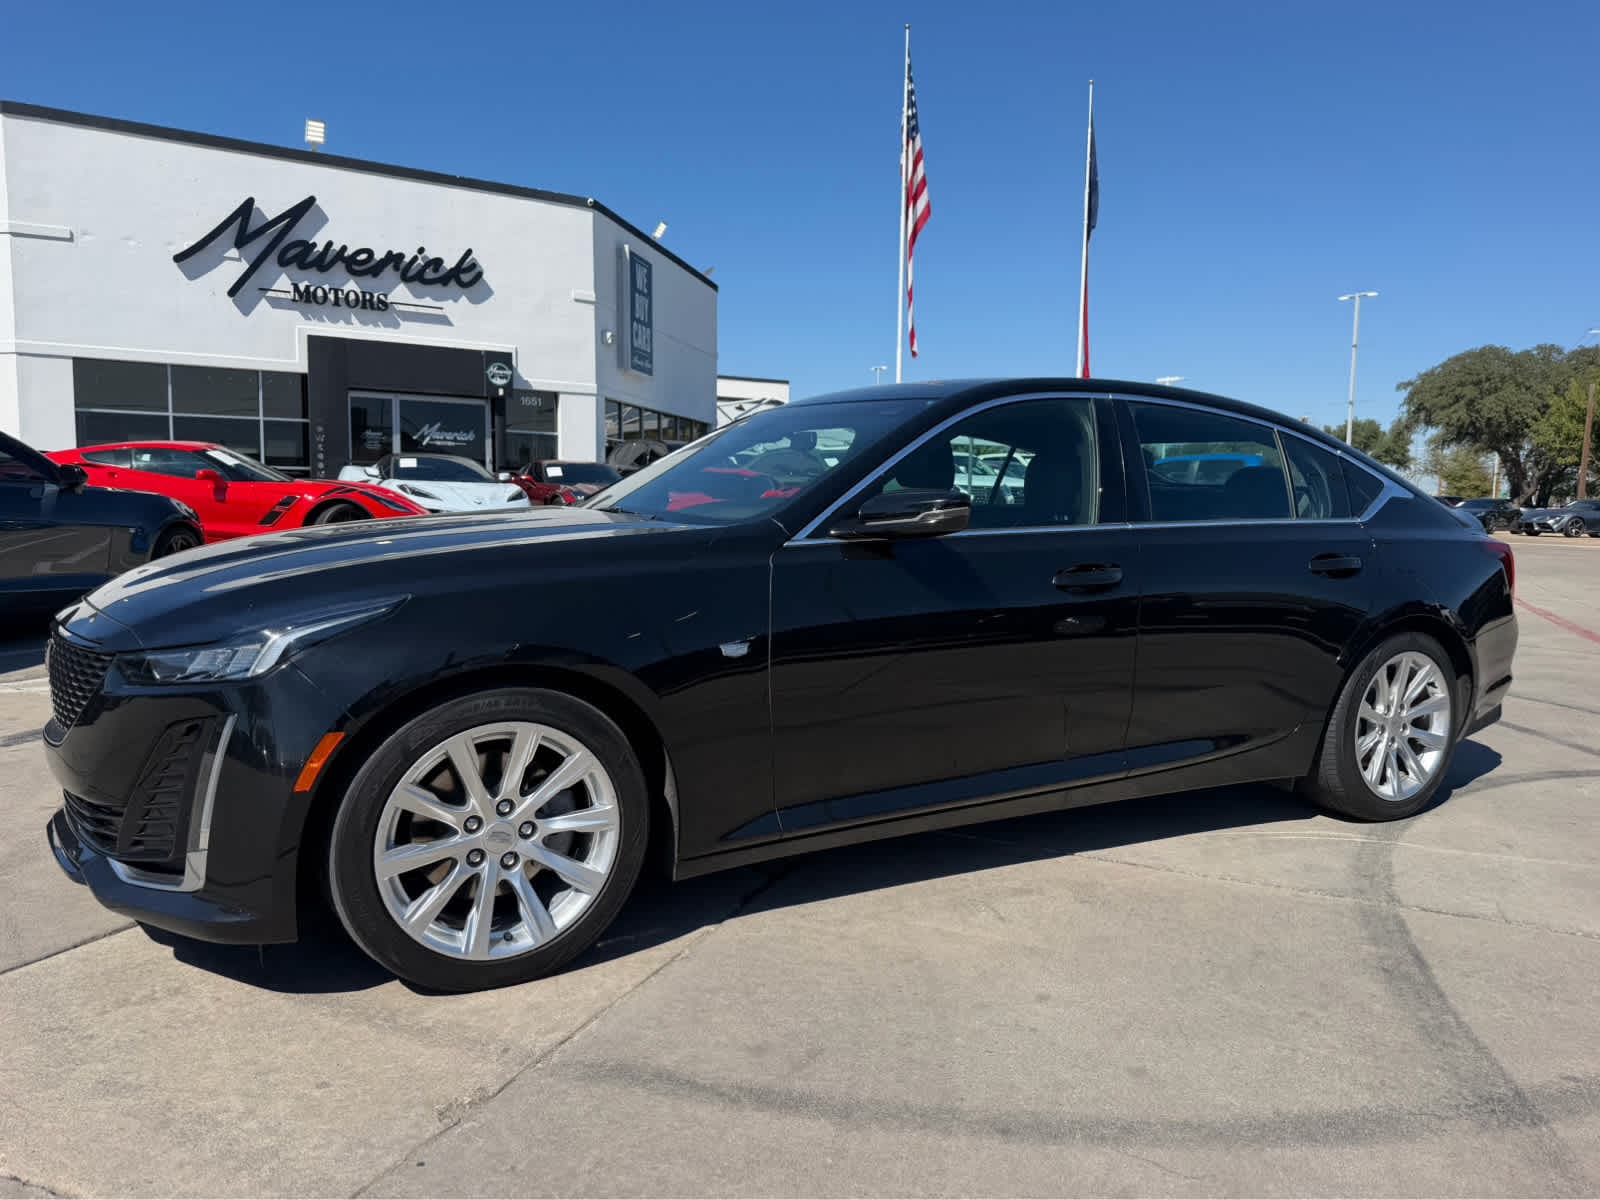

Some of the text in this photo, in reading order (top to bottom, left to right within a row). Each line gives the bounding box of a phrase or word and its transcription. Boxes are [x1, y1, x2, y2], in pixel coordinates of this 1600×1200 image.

[173, 195, 483, 298] Maverick
[635, 263, 648, 294] WE
[290, 283, 390, 312] MOTORS
[632, 319, 651, 353] CARS
[412, 421, 476, 446] Maverick
